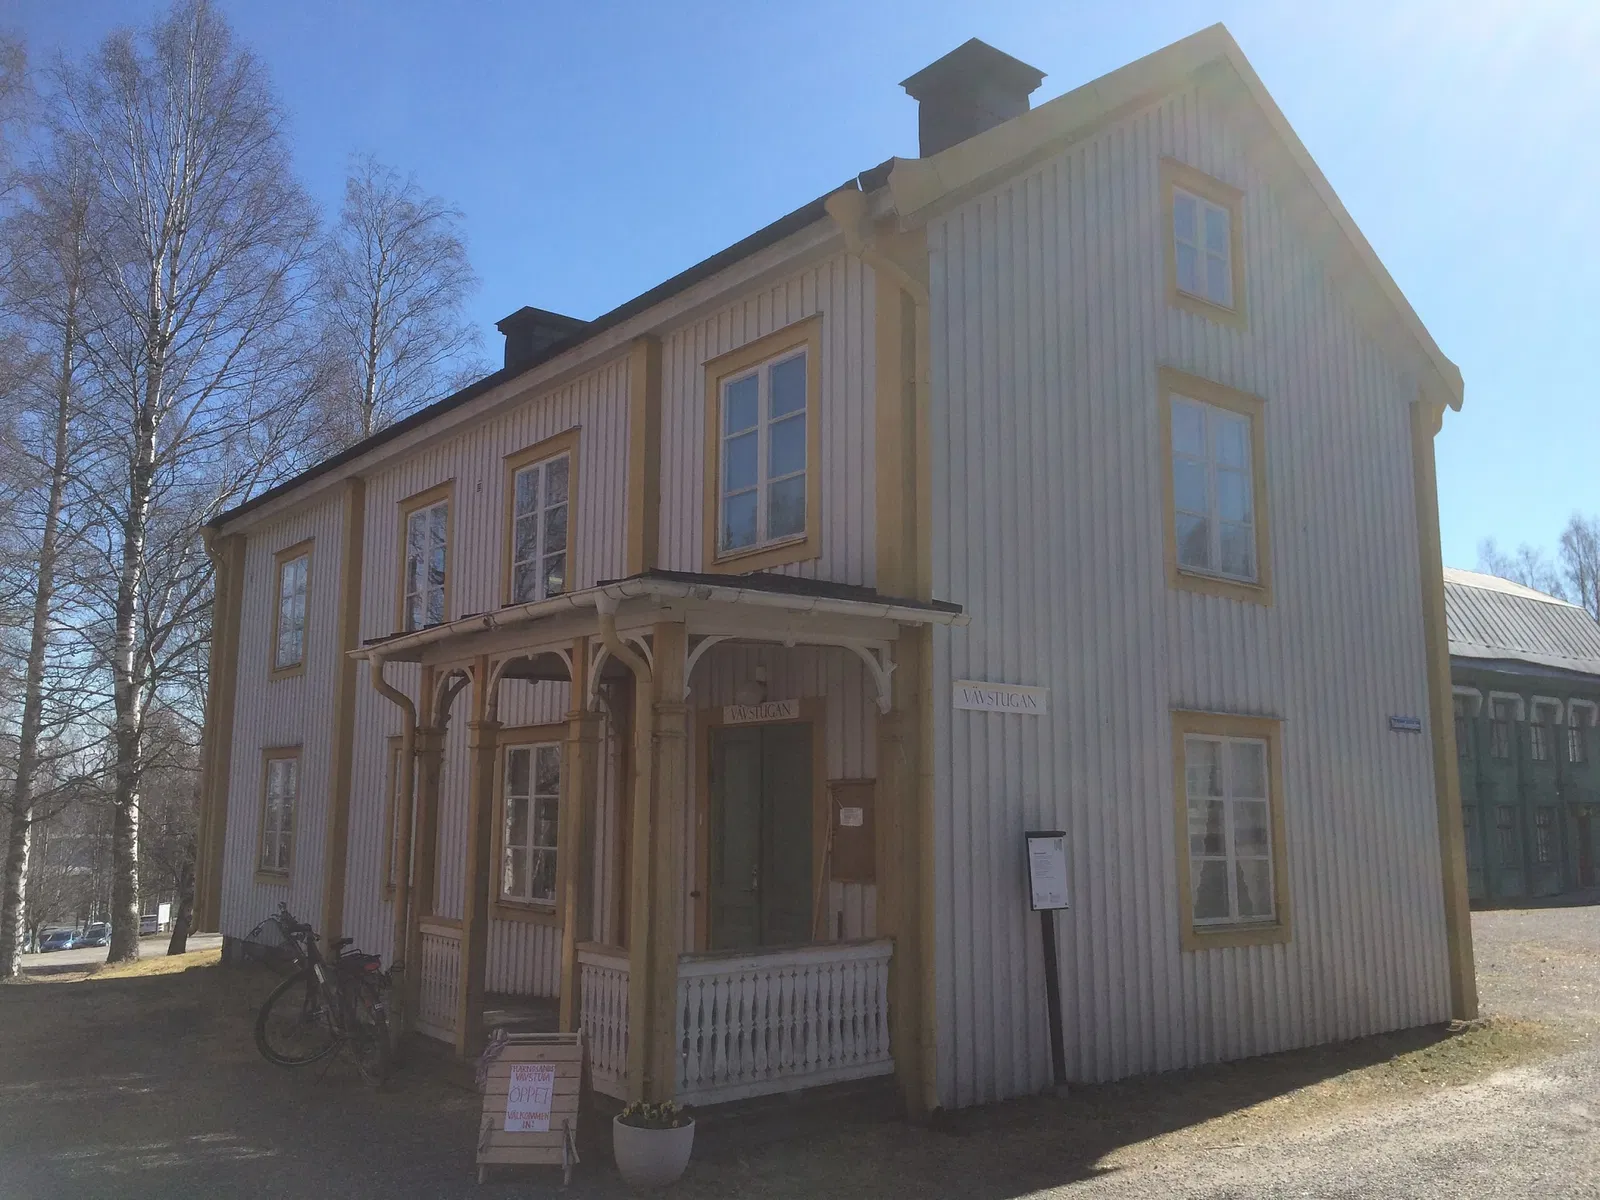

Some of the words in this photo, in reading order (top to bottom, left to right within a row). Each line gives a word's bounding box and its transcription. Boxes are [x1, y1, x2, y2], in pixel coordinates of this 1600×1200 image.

[963, 685, 1036, 708] VÄVSTUGAN
[731, 703, 791, 720] VÄVSTUGAN
[509, 1085, 551, 1104] ÖPPET
